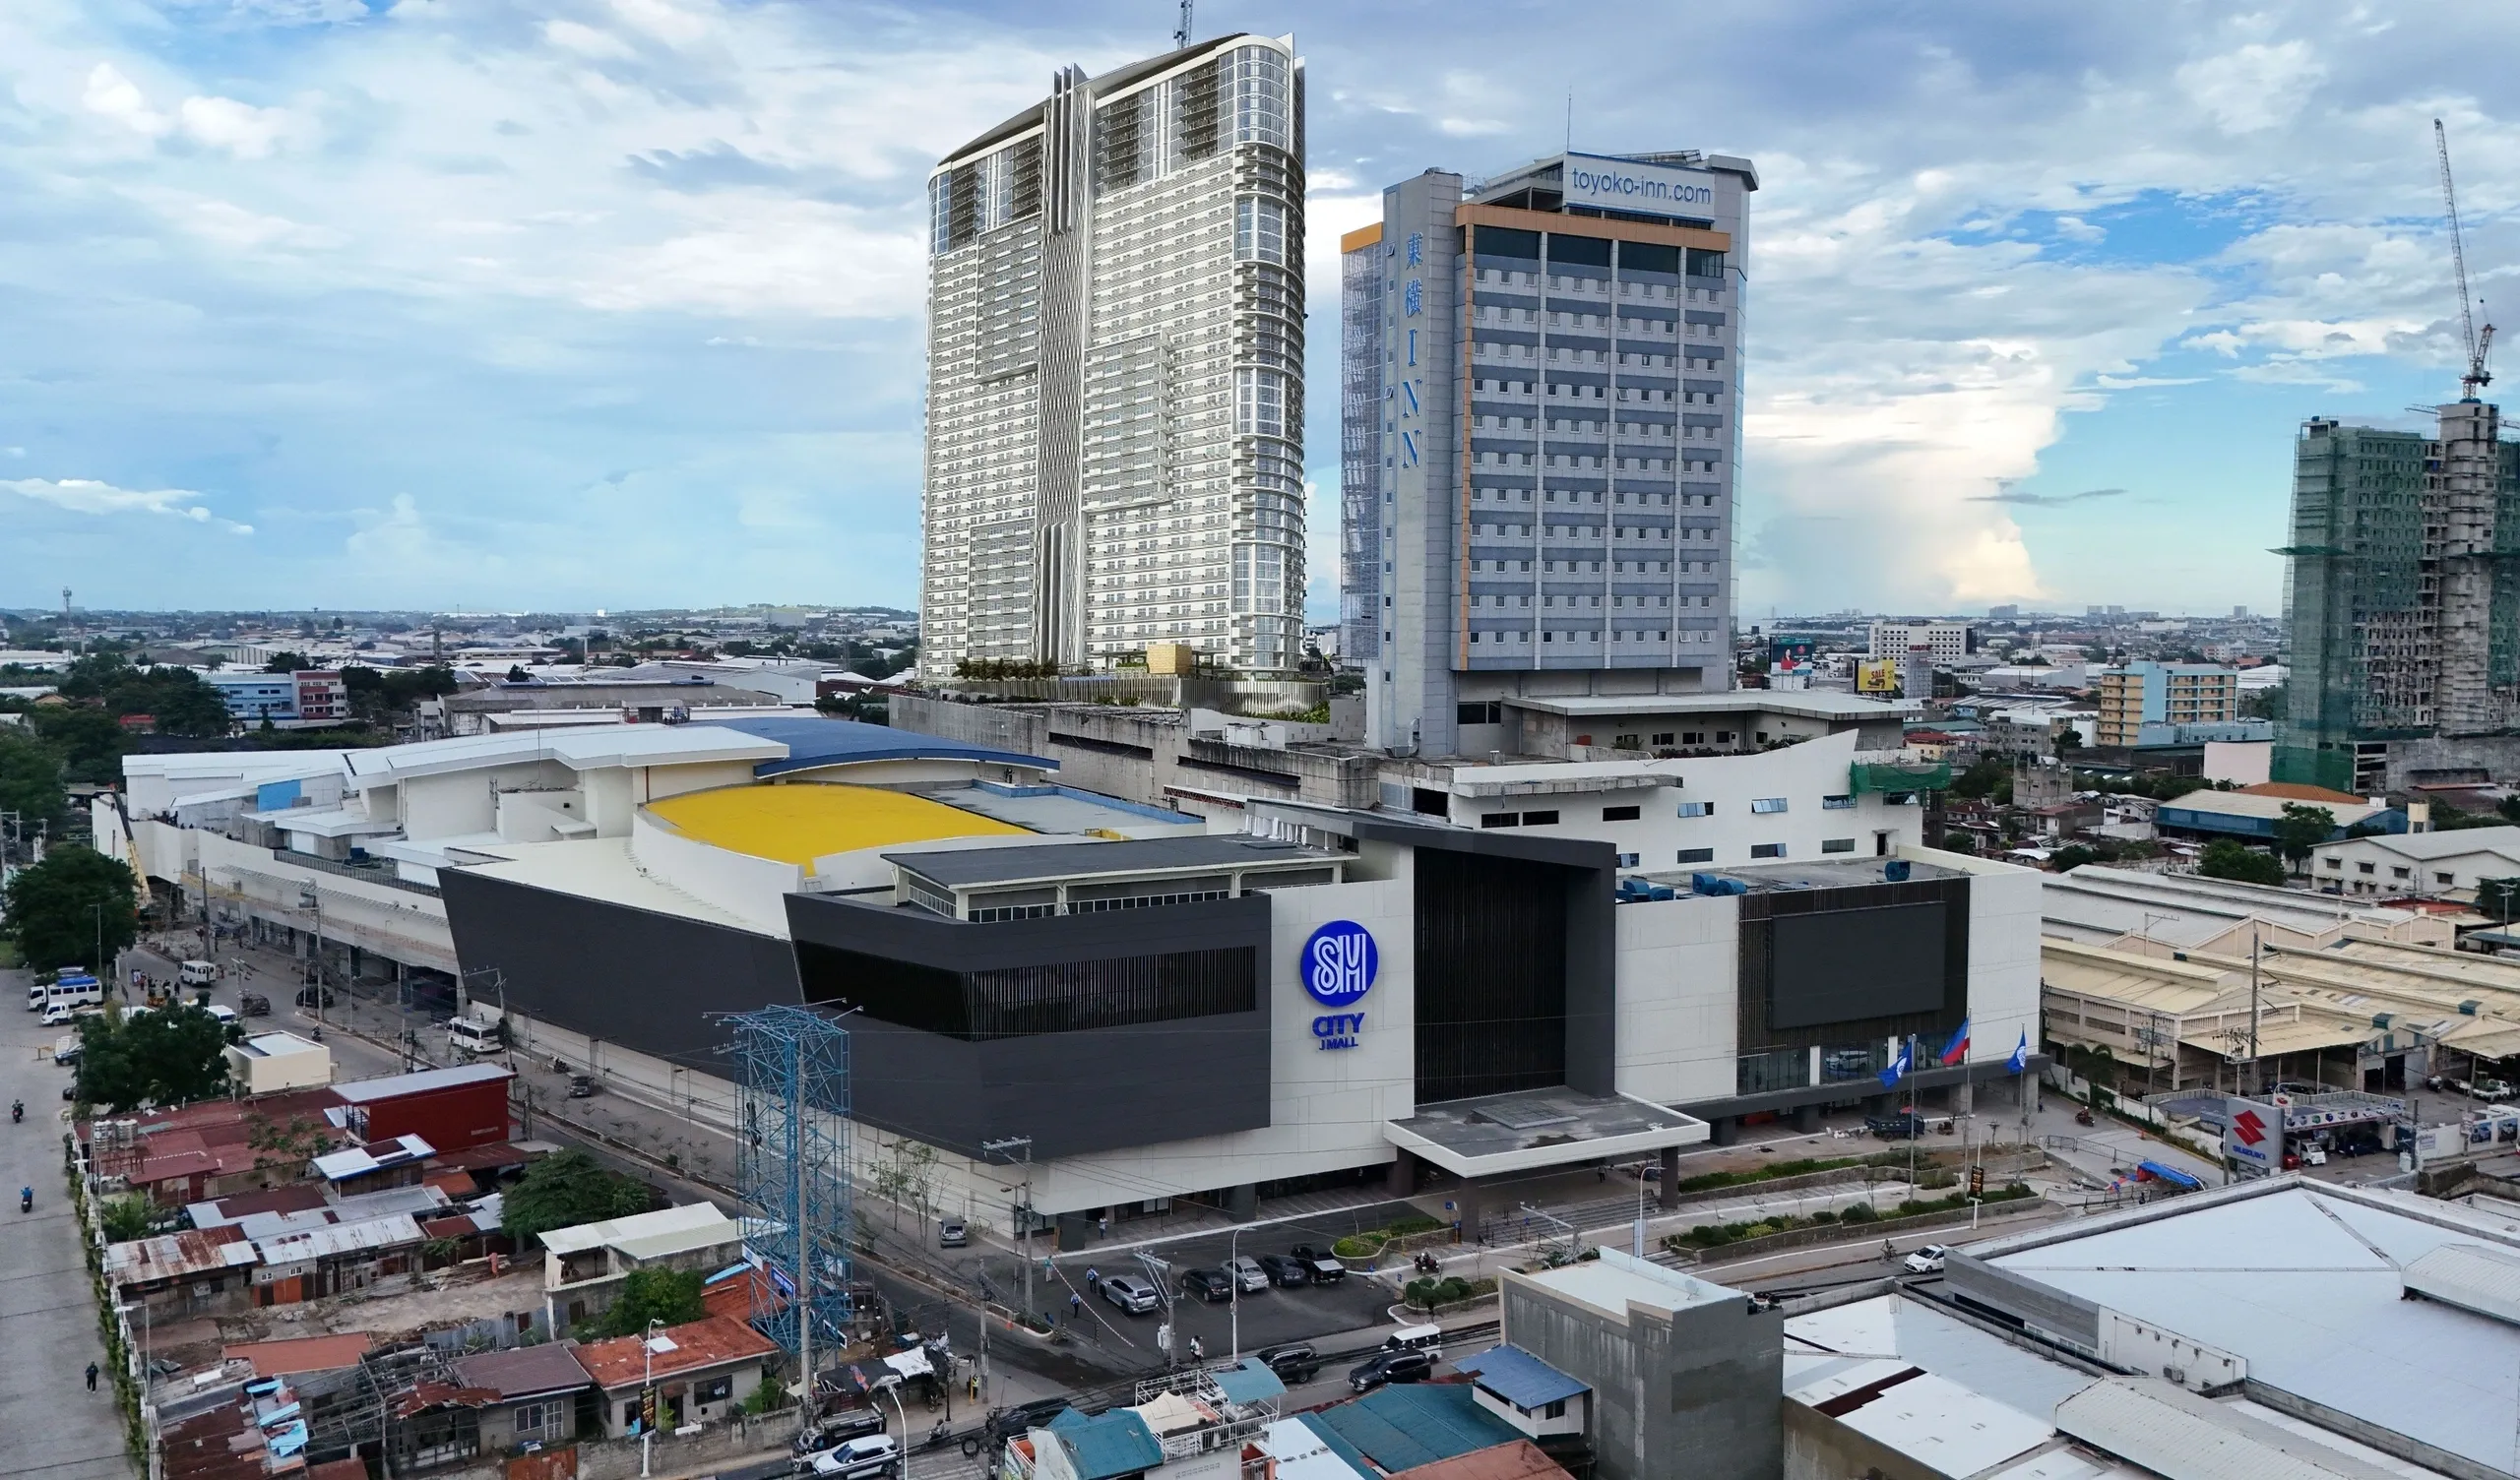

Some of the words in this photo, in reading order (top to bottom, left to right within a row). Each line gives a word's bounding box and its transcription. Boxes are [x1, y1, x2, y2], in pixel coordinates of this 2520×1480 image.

[1571, 167, 1711, 205] toyoko-inn.com
[1870, 668, 1885, 680] SALE
[1312, 933, 1366, 996] SM
[1312, 1012, 1365, 1037] CITY
[2232, 1144, 2266, 1160] SUZUKI
